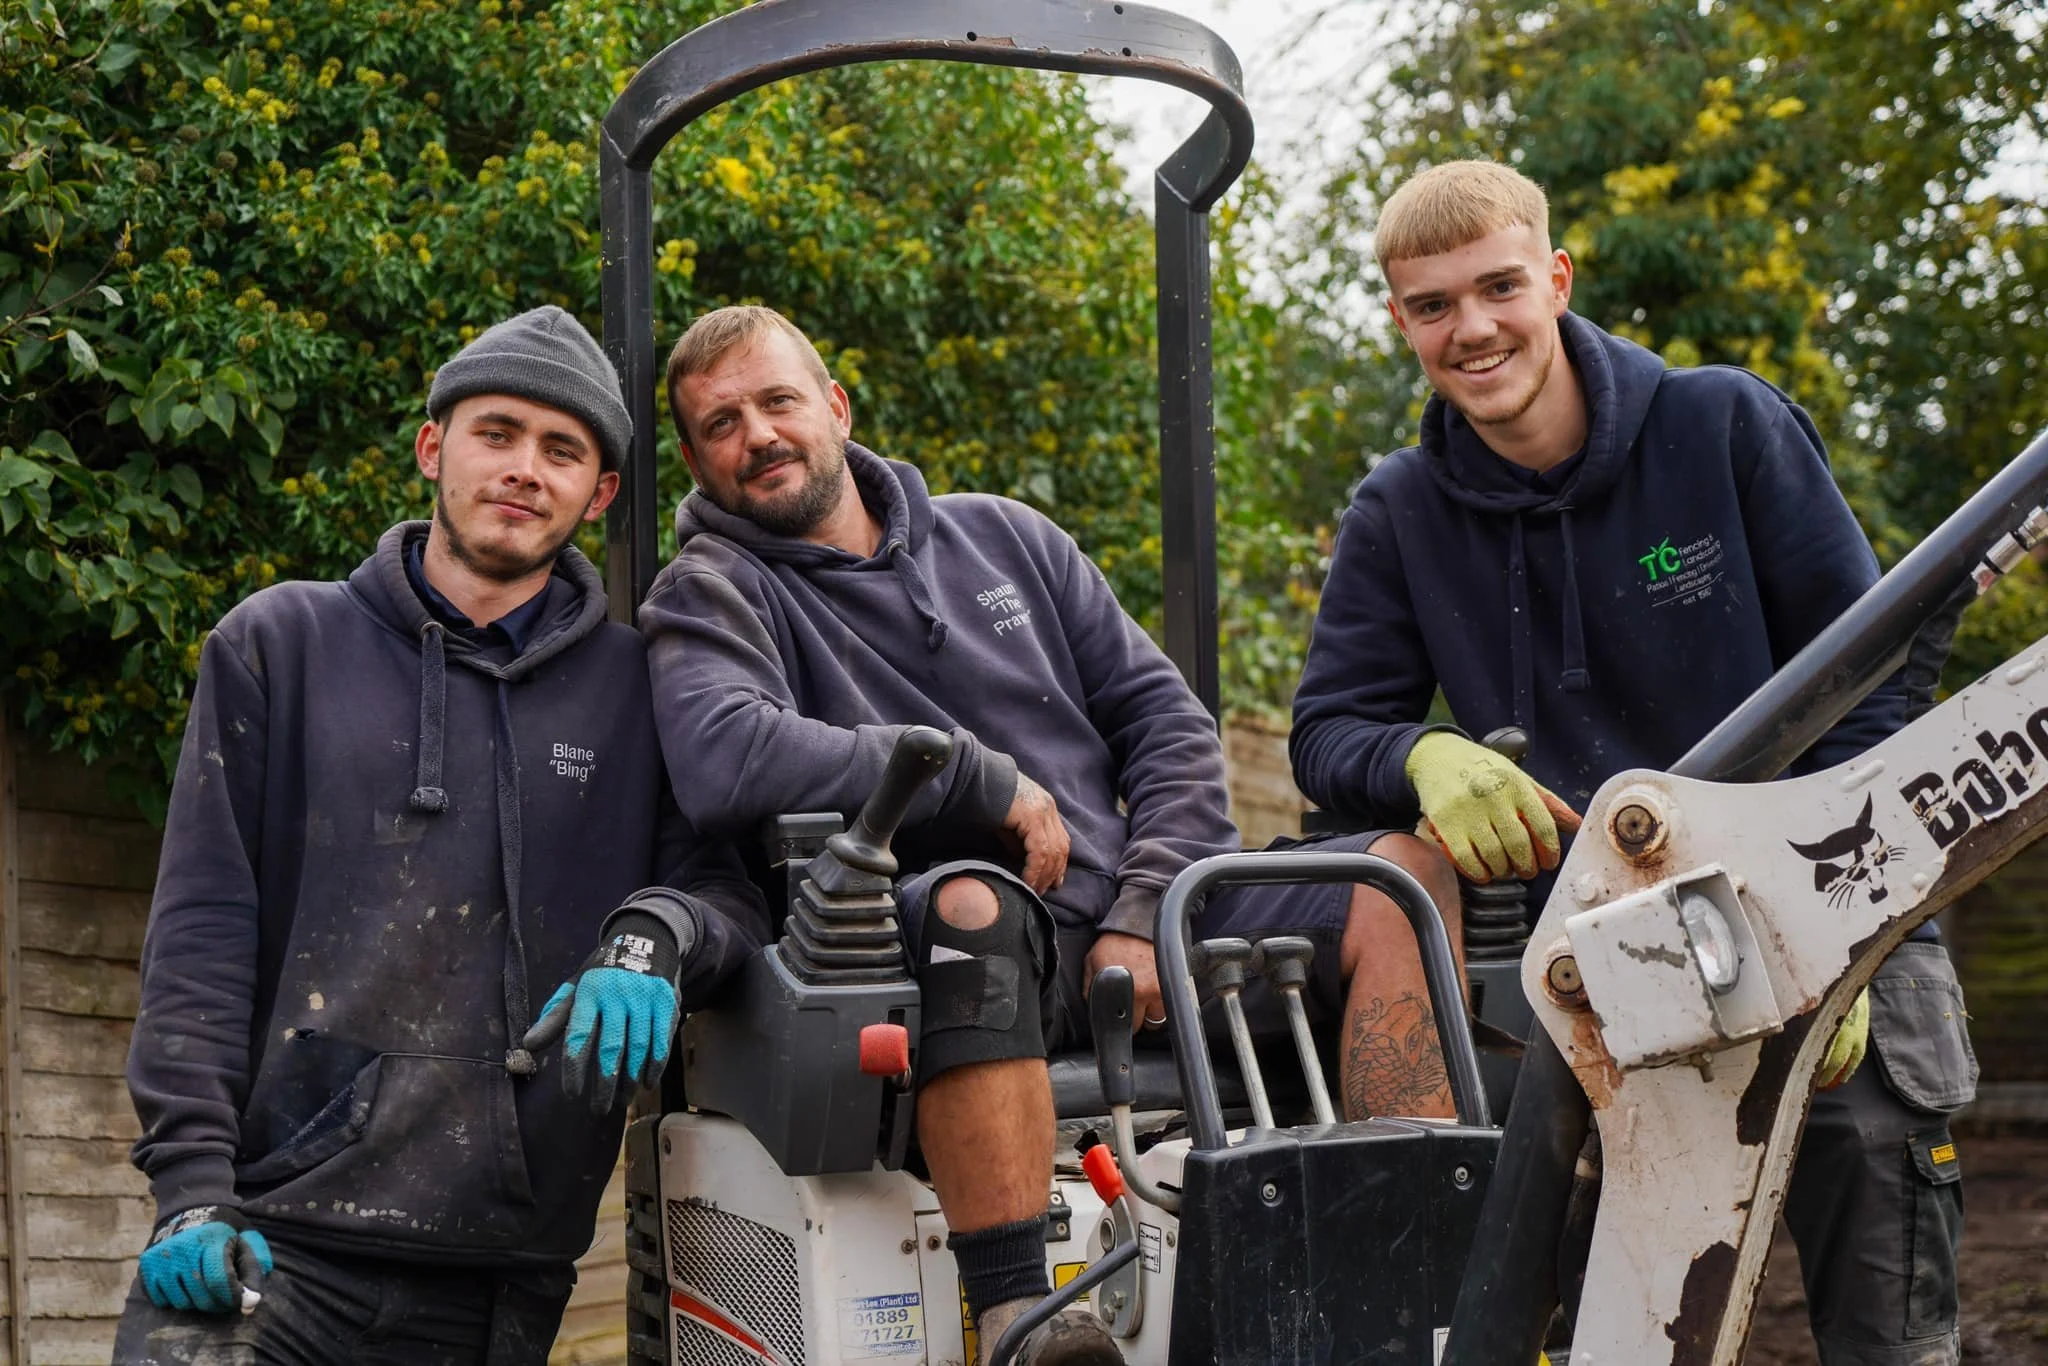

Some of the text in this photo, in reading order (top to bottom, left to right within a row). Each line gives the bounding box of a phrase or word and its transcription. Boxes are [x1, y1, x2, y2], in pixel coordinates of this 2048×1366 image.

[976, 583, 1016, 606] Shaun
[553, 743, 594, 761] Blane
[549, 759, 596, 783] "Bing"
[905, 1295, 917, 1303] Ltd
[855, 1309, 908, 1326] 01889
